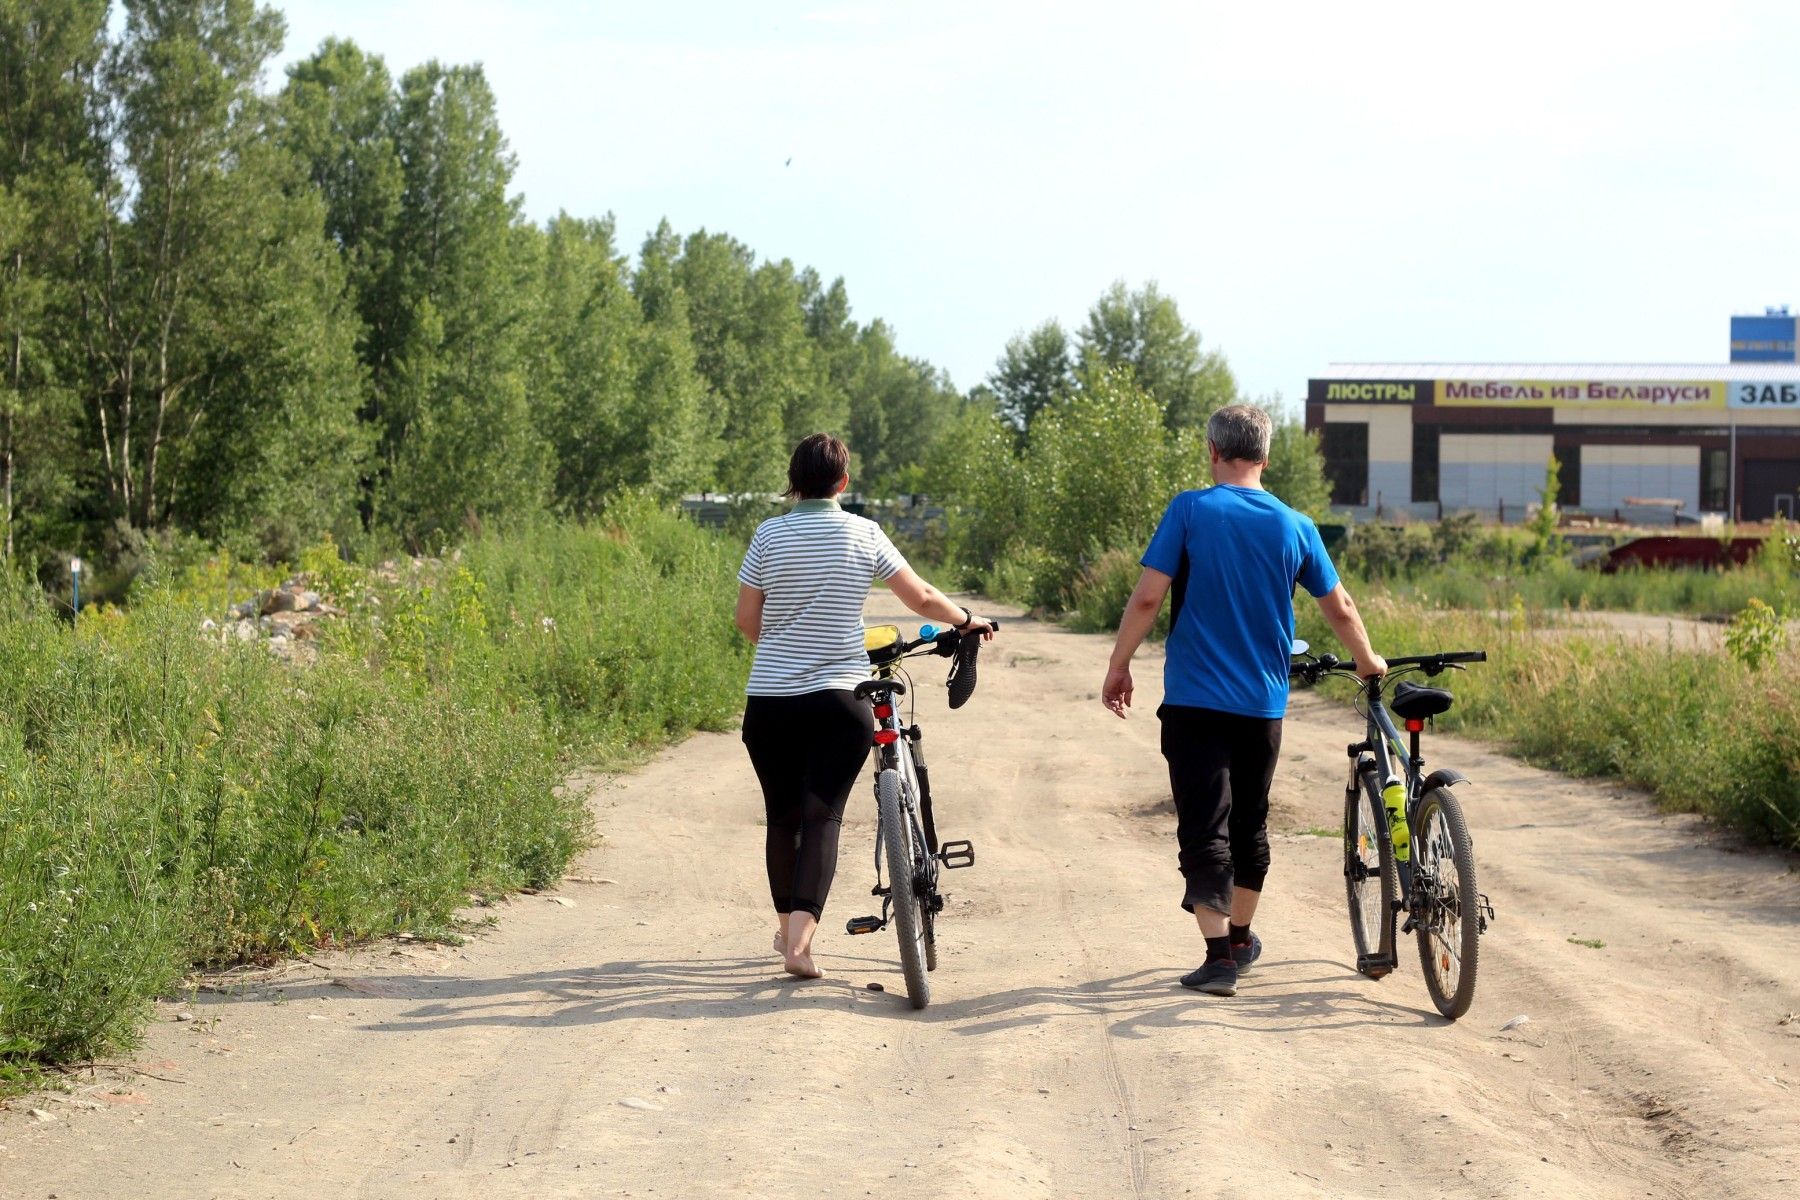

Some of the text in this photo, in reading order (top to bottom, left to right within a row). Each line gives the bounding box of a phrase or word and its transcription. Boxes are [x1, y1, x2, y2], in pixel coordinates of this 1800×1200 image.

[1327, 383, 1415, 400] ЛЮСТРЫ
[1445, 382, 1711, 403] Мебель из Беларуси
[1740, 384, 1800, 404] ЗАБ
